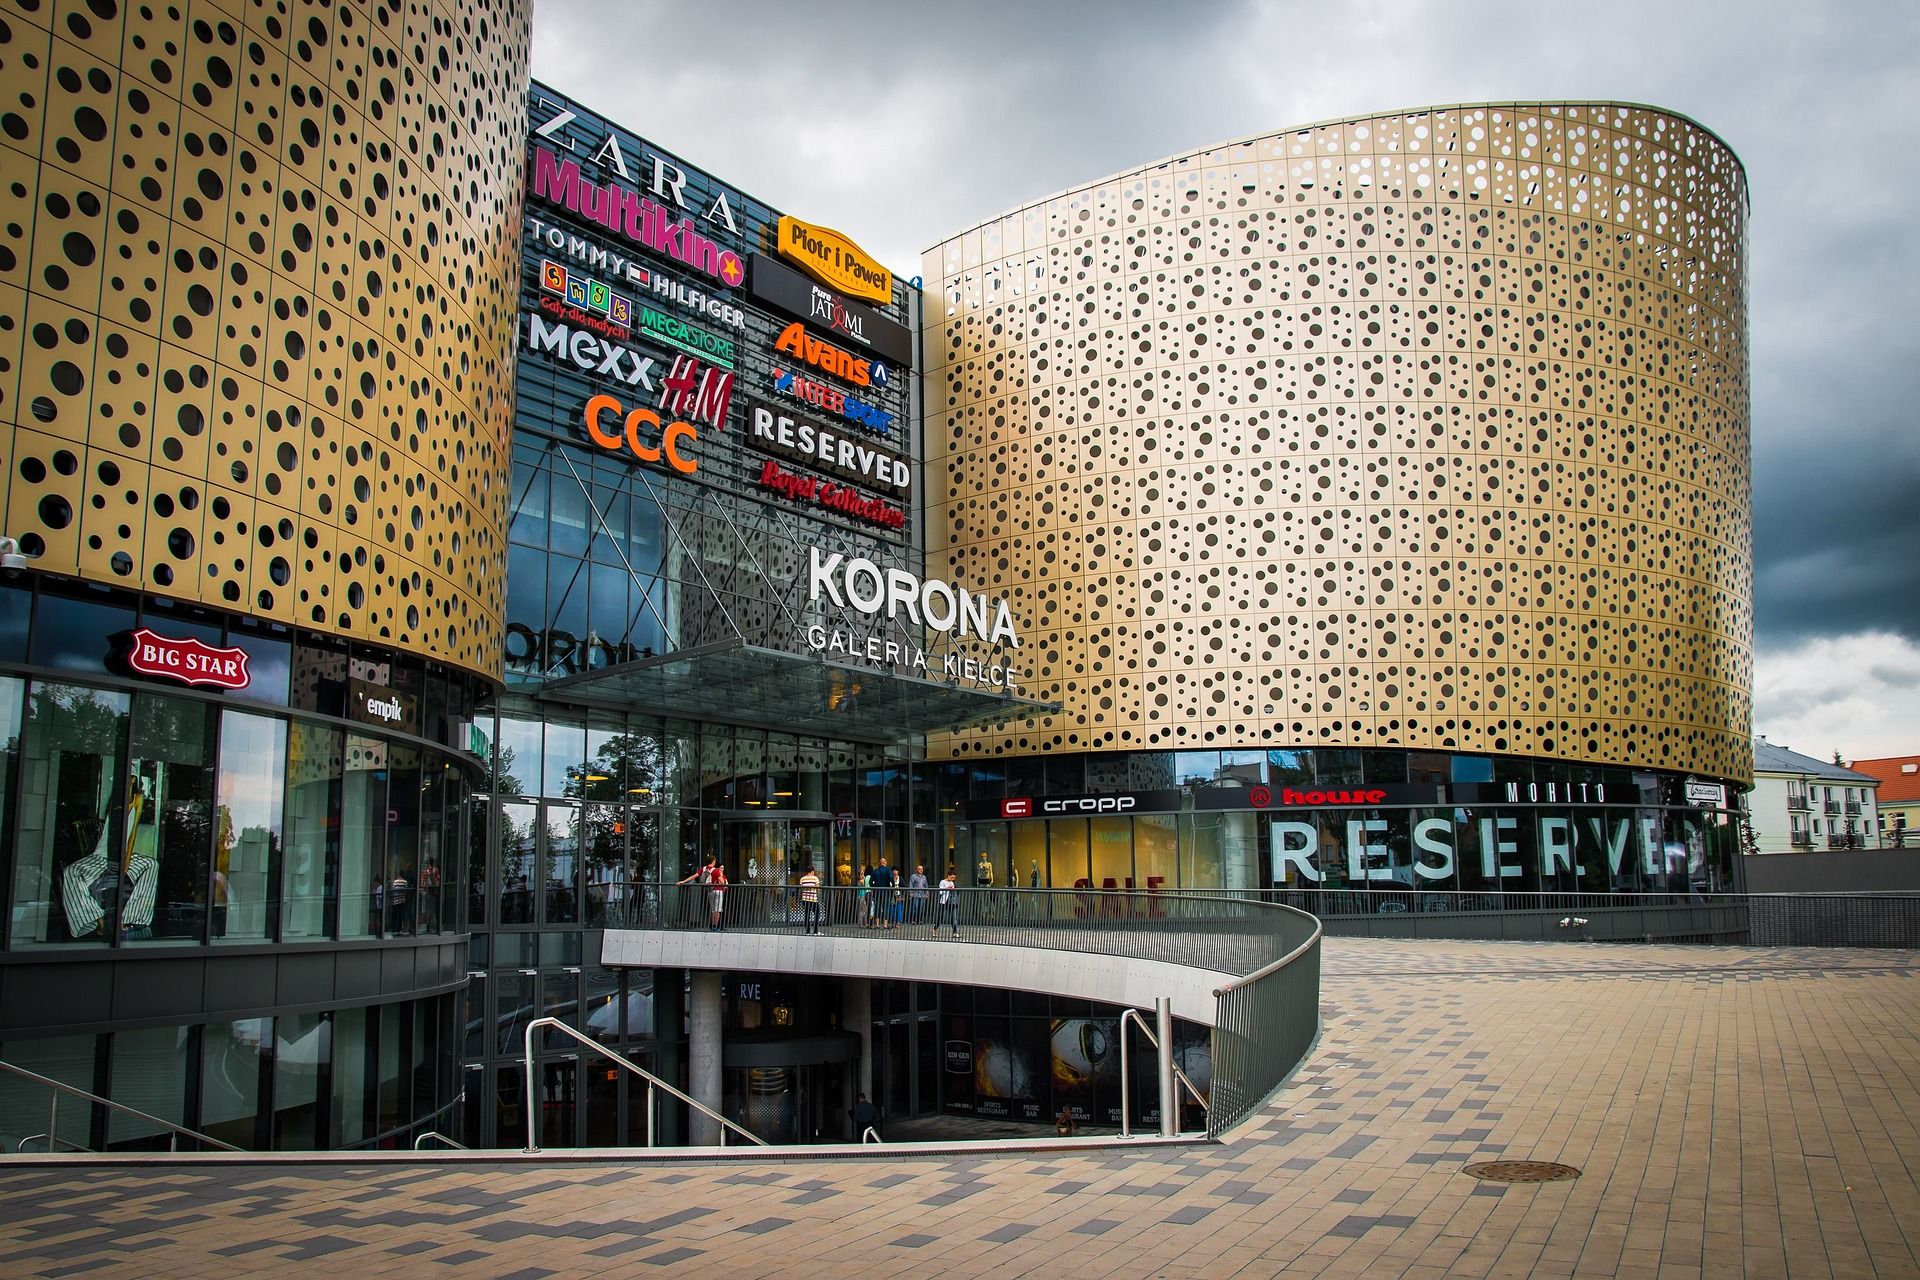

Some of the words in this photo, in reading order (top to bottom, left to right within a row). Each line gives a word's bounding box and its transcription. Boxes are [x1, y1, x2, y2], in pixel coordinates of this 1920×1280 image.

[535, 97, 743, 237] ZARA
[534, 146, 745, 288] Multikino
[792, 223, 832, 261] Piotr
[835, 246, 841, 268] i
[531, 218, 625, 275] TOMMY
[653, 273, 747, 331] HILFIGER
[811, 285, 832, 301] Pure
[641, 307, 734, 361] MEGASTORE
[774, 321, 871, 387] Avans
[658, 353, 735, 433] H&M
[793, 375, 895, 434] INTERSPORT
[584, 394, 698, 474] CCC
[754, 407, 910, 488] RESERVED
[760, 460, 817, 500] Royal
[818, 482, 906, 529] Collection
[808, 545, 1020, 649] KORONA
[143, 644, 180, 667] BIG
[186, 653, 238, 678] STAR
[807, 624, 928, 671] GALERIA
[943, 652, 1019, 689] KIELCE
[367, 697, 403, 722] empik
[1043, 796, 1136, 813] cropp
[1281, 787, 1387, 805] house
[1506, 782, 1606, 803] MOHITO
